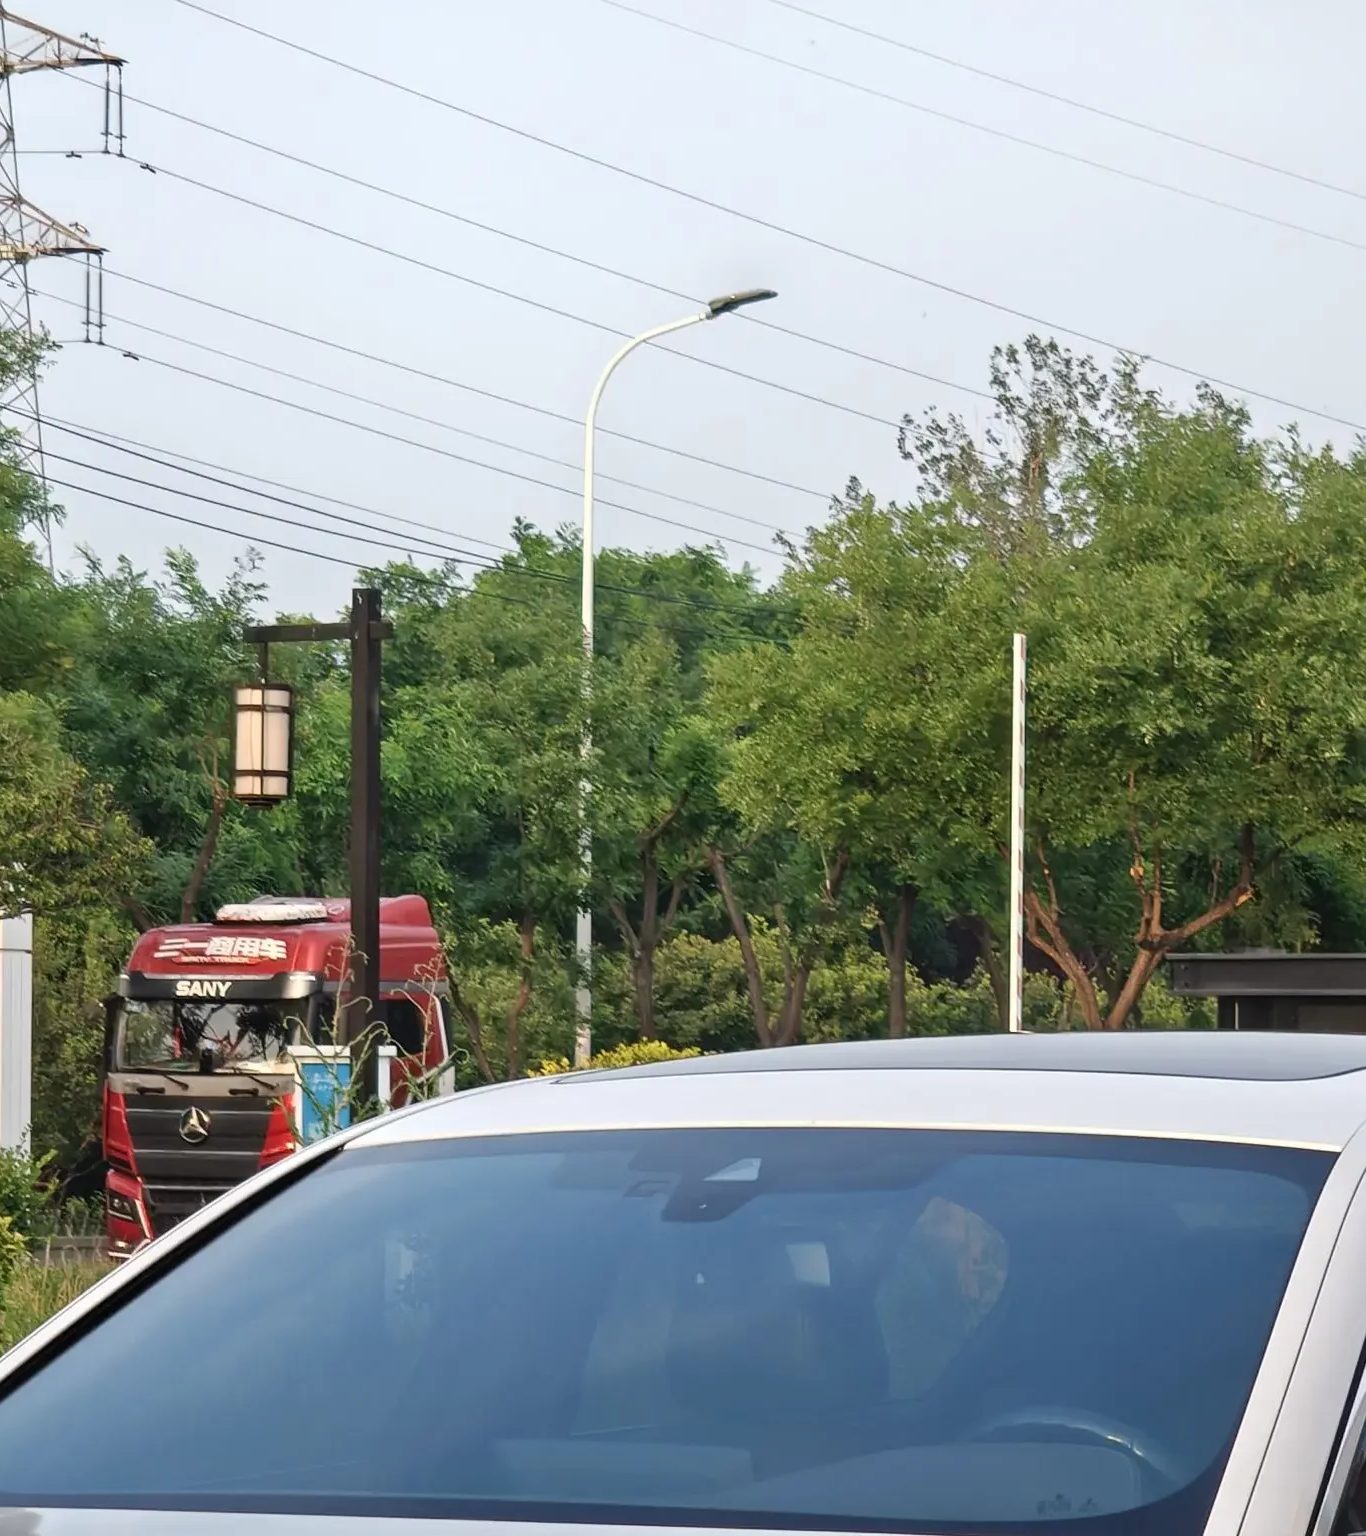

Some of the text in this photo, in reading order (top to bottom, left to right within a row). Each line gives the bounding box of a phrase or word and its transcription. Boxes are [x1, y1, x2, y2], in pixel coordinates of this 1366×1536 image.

[153, 936, 287, 960] 三一商用车
[176, 981, 232, 997] SANY
